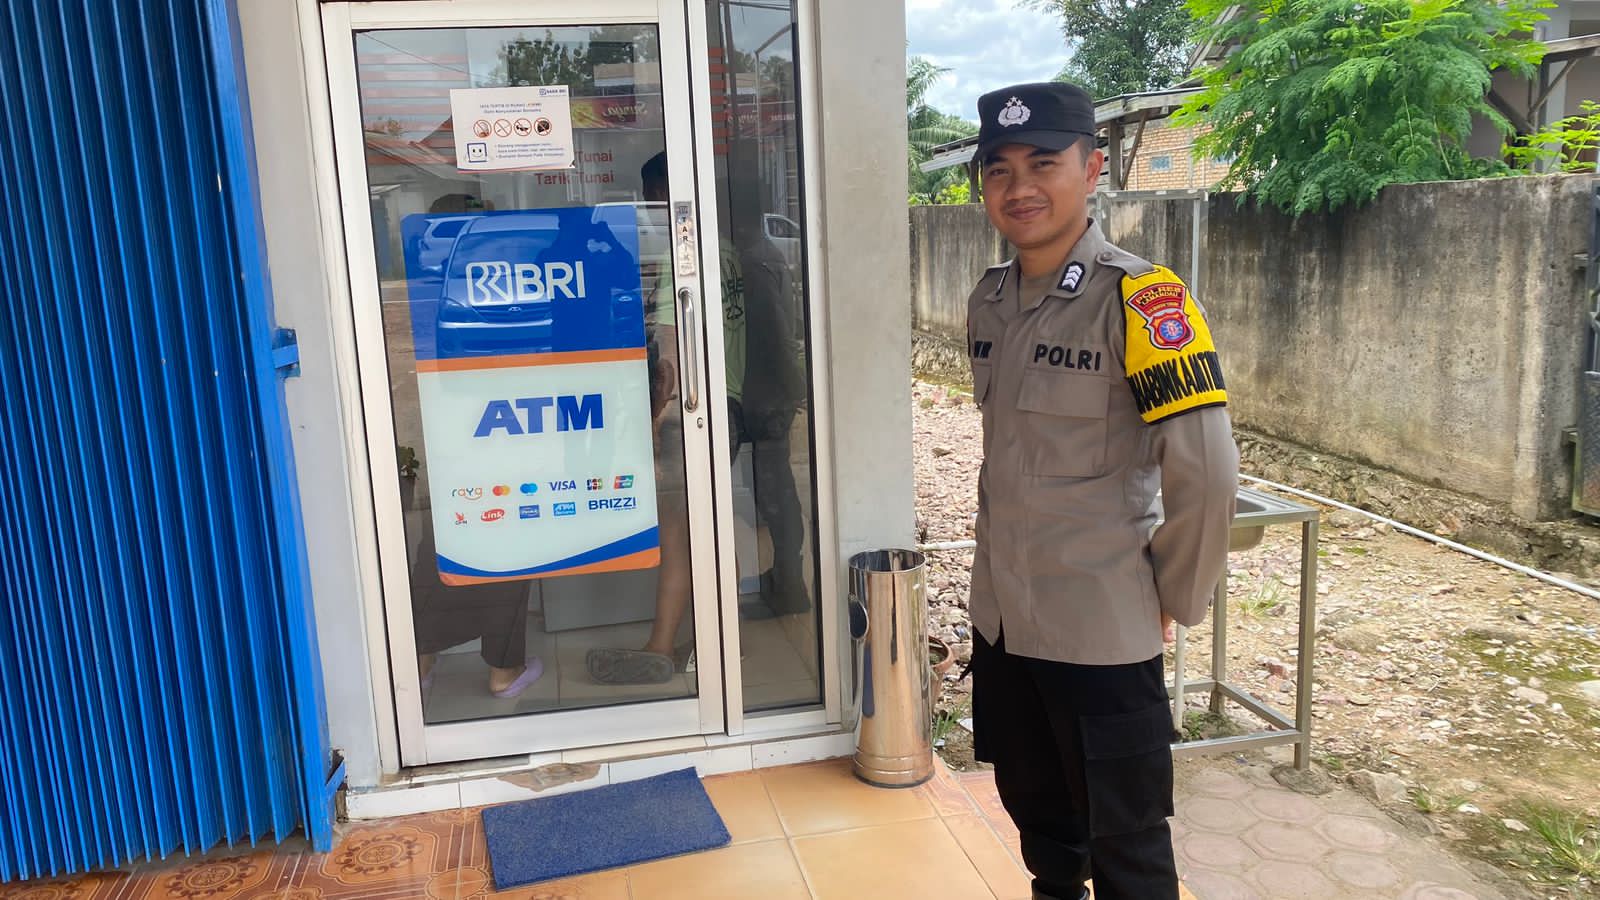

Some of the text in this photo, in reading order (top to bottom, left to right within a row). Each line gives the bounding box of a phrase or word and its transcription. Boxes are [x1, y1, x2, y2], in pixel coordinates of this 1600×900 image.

[578, 149, 613, 163] Tunai
[535, 170, 614, 185] Tarik Tunai
[1034, 343, 1101, 371] POLRI
[473, 393, 604, 438] ATM
[550, 480, 577, 491] VISA
[588, 497, 636, 510] BRIZZI
